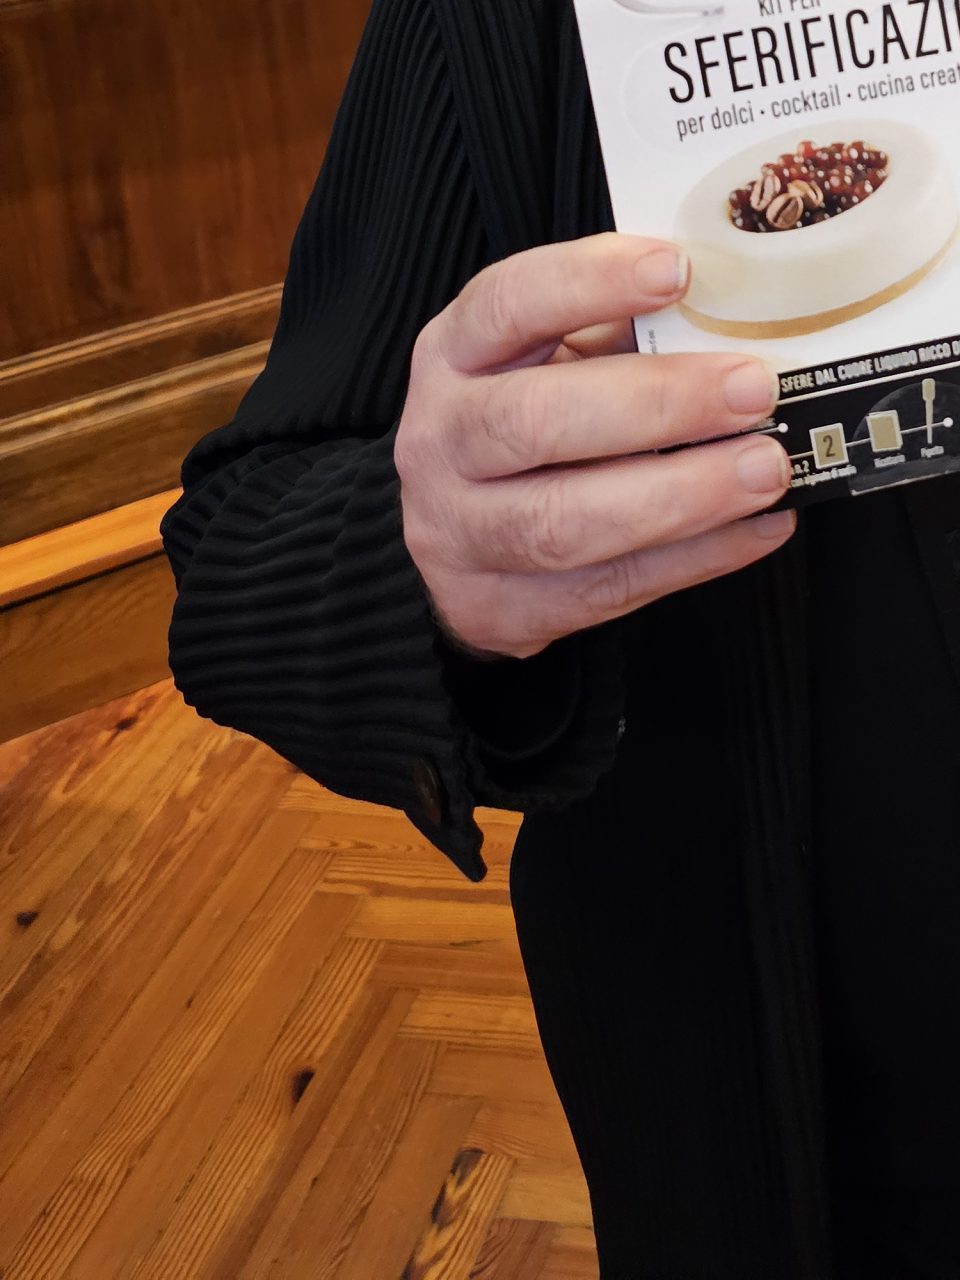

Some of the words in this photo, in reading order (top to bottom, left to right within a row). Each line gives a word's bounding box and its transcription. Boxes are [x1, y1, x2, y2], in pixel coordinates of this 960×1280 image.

[676, 113, 705, 142] per
[711, 101, 755, 132] dolci
[771, 85, 842, 119] cocktail
[857, 72, 916, 102] cucina
[780, 371, 815, 393] SFERE
[814, 367, 838, 386] DAL
[918, 341, 952, 363] RICCO
[822, 435, 836, 458] 2
